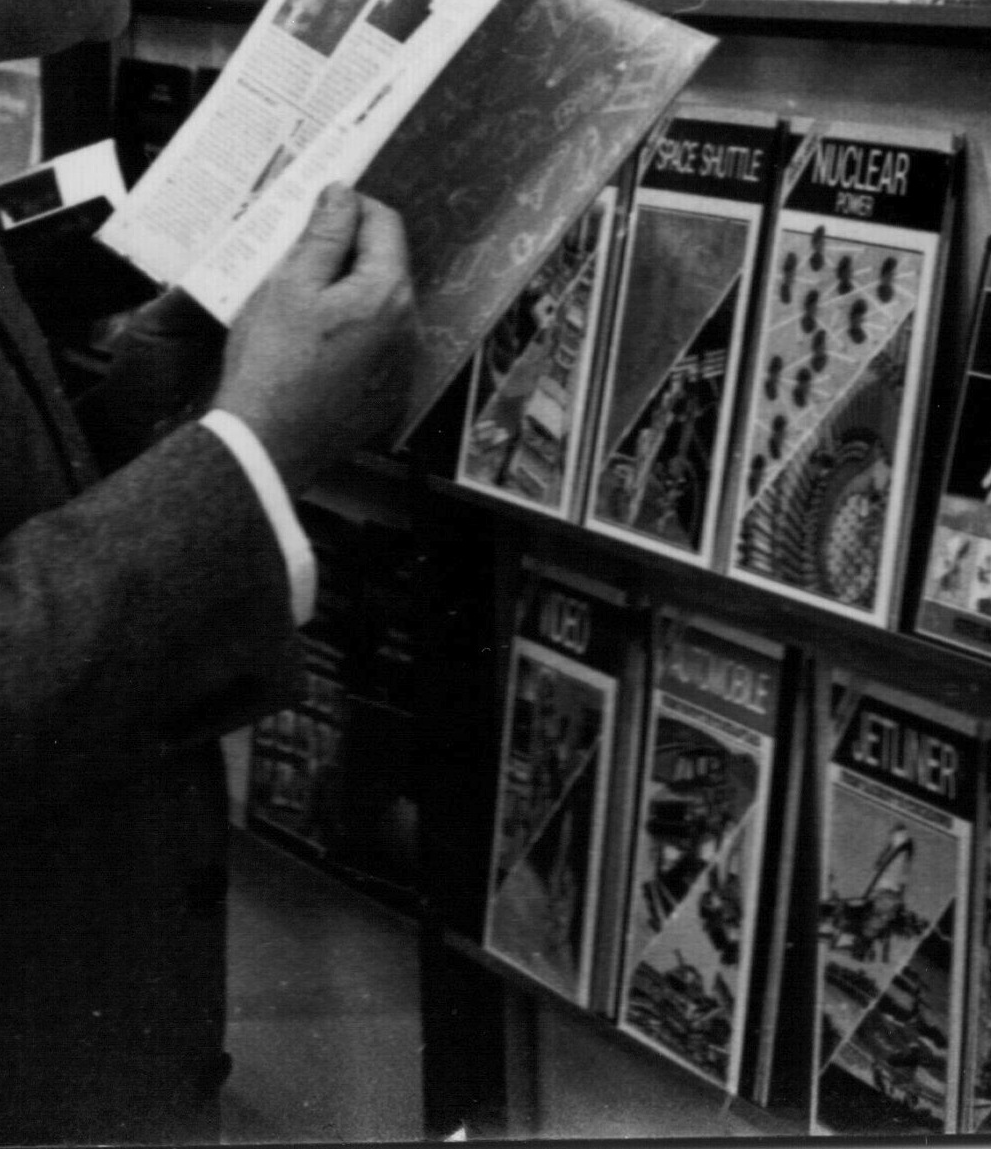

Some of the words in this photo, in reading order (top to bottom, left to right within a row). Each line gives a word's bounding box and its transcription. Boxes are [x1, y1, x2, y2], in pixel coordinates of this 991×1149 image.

[656, 137, 699, 174] SPACE
[700, 142, 764, 183] SHUTTLE
[811, 140, 910, 196] NUCLEAR
[835, 191, 874, 217] POWER
[540, 592, 591, 655] VIDEO
[852, 711, 959, 800] JETLINER
